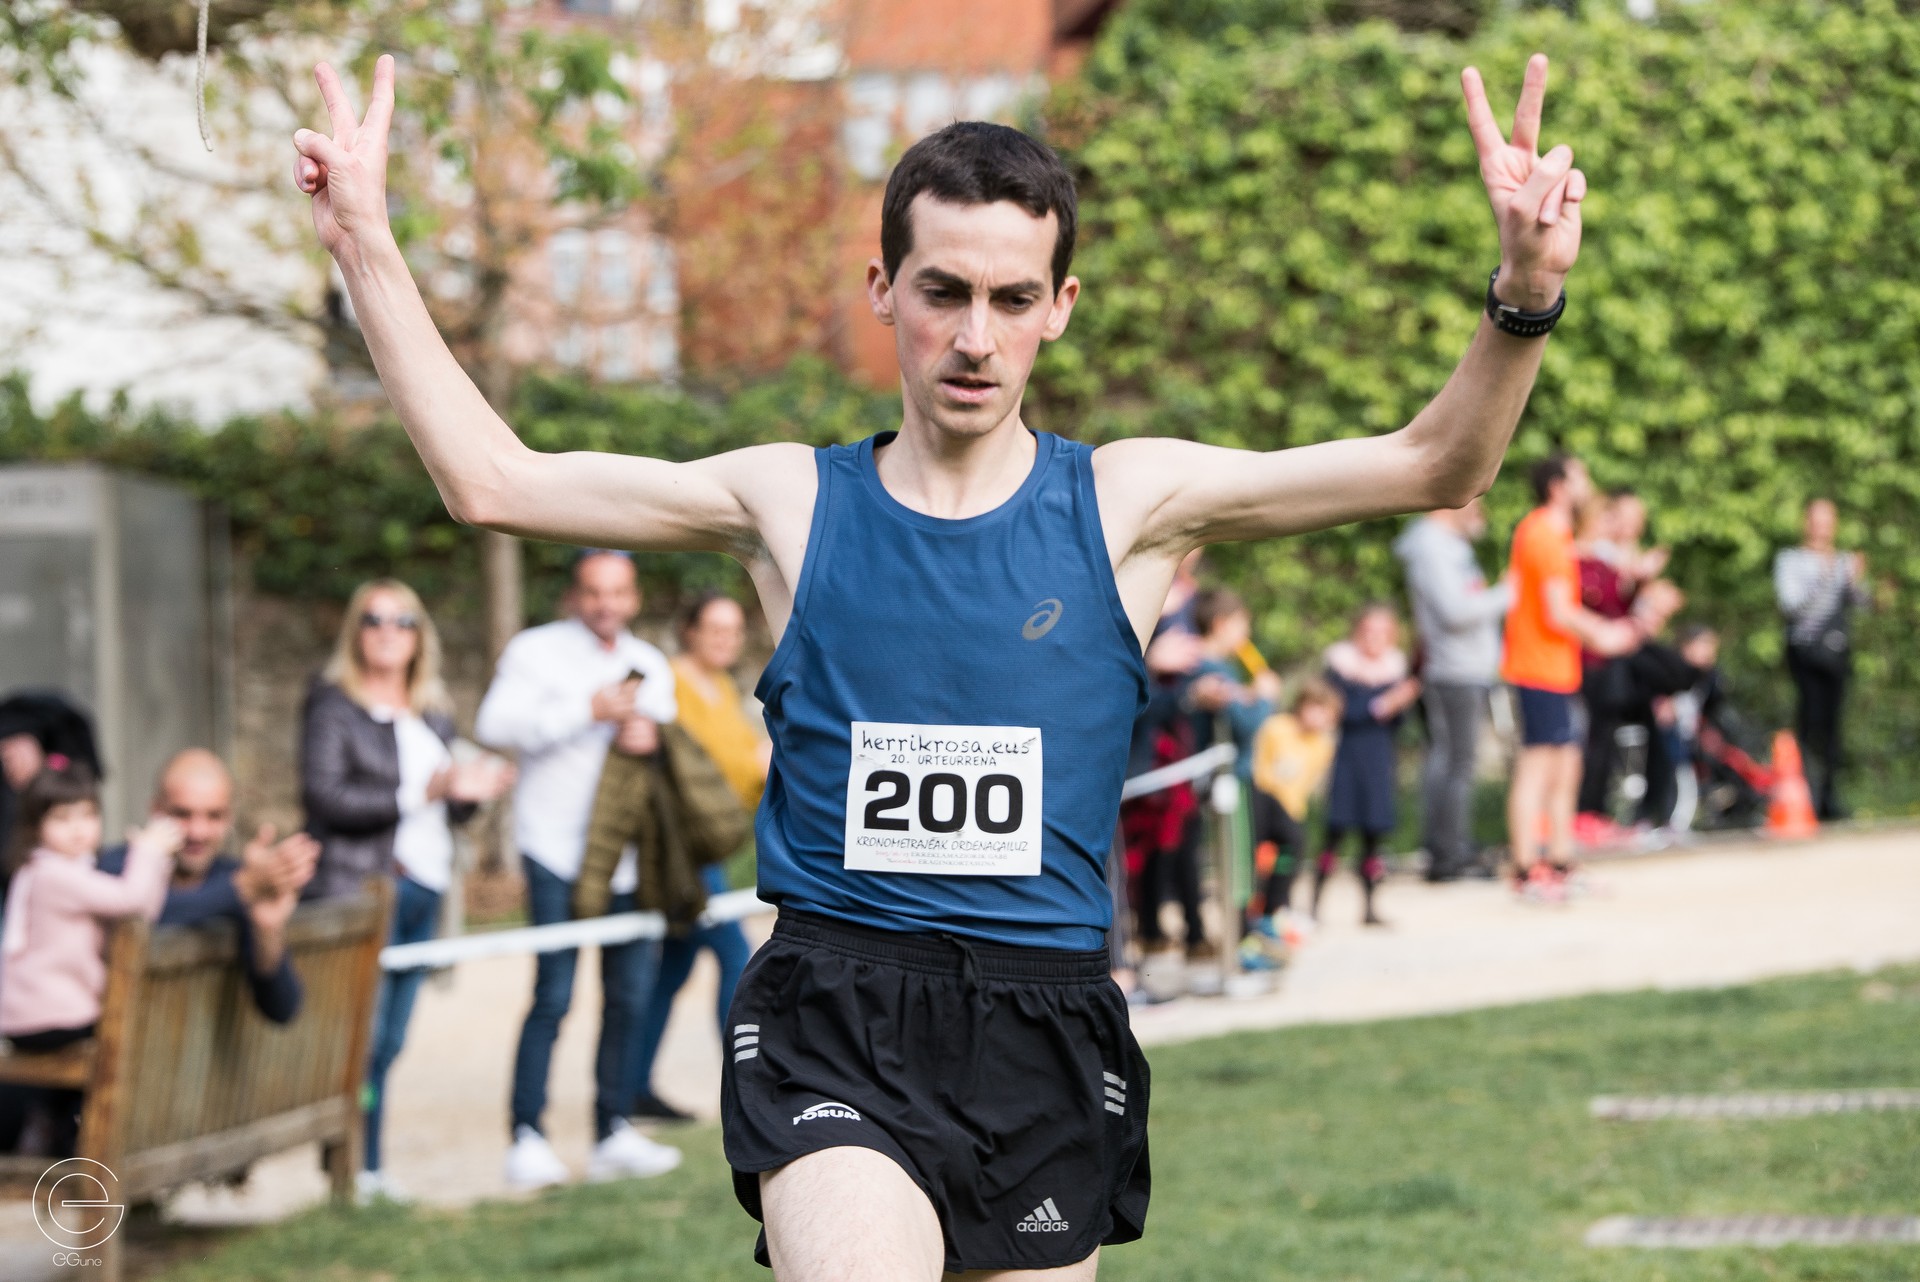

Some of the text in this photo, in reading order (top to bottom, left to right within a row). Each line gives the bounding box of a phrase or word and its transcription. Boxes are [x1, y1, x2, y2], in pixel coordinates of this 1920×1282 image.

[862, 730, 1031, 755] herrikrosa.eus
[890, 753, 997, 767] 20. URTEURRENA
[863, 769, 1024, 835] 200
[792, 1109, 862, 1126] FORUM
[1016, 1219, 1069, 1232] adidas
